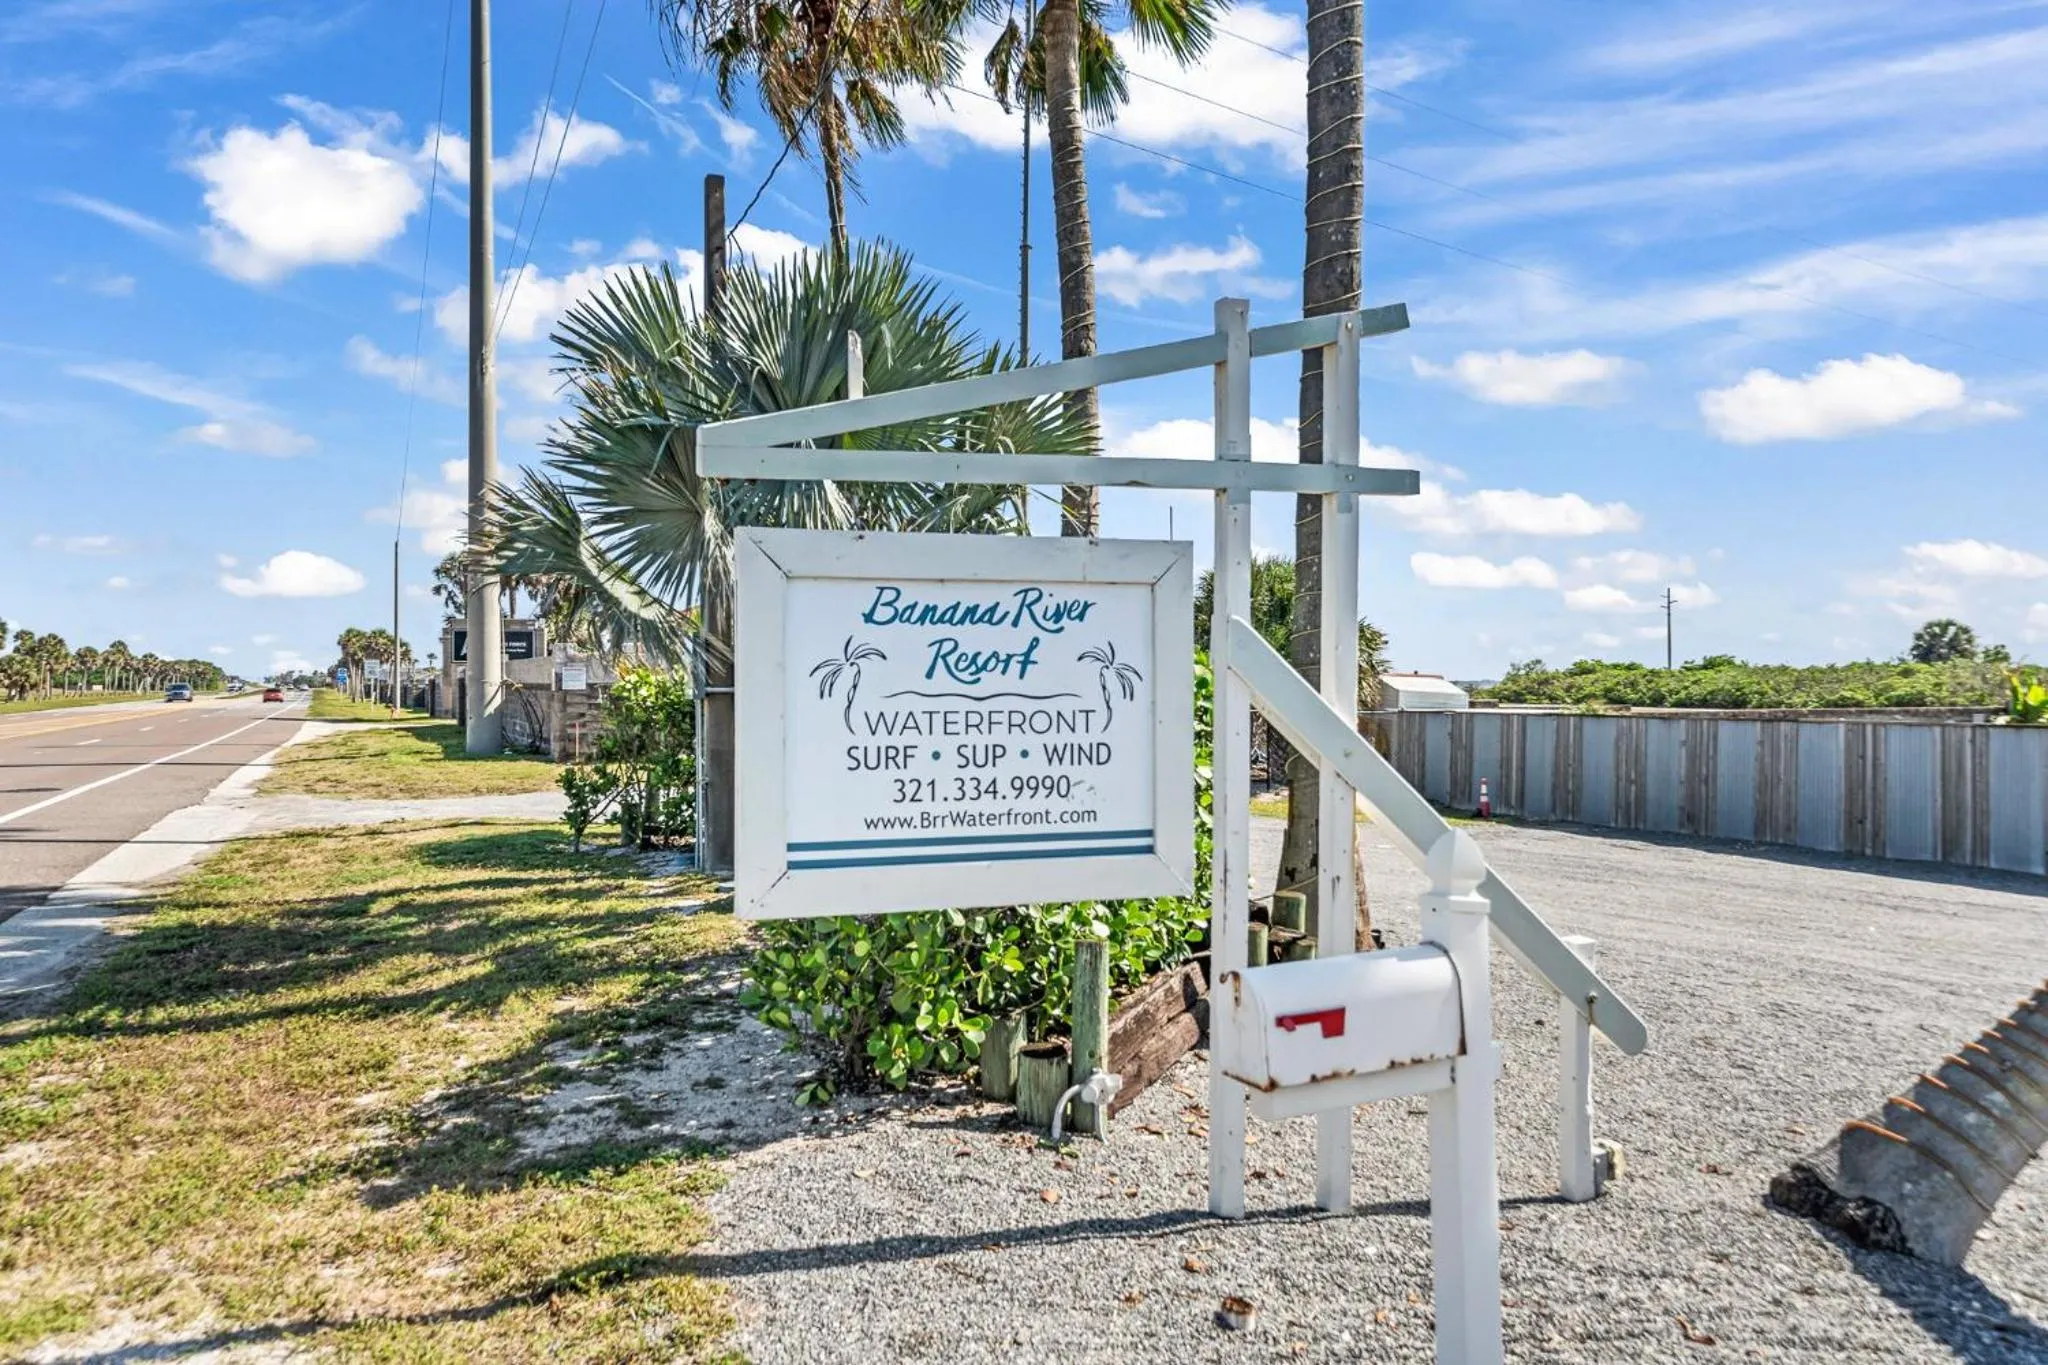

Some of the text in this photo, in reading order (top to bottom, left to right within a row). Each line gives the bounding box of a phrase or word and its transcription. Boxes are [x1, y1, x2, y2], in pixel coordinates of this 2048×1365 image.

[861, 586, 1097, 635] Banana River
[925, 636, 1041, 686] Resort
[864, 709, 1097, 737] WATERFRONT
[846, 741, 1112, 771] SURF SUP WIND
[892, 774, 1072, 804] 321.334.9990
[863, 808, 1098, 832] www.BrrWaterfront.com
